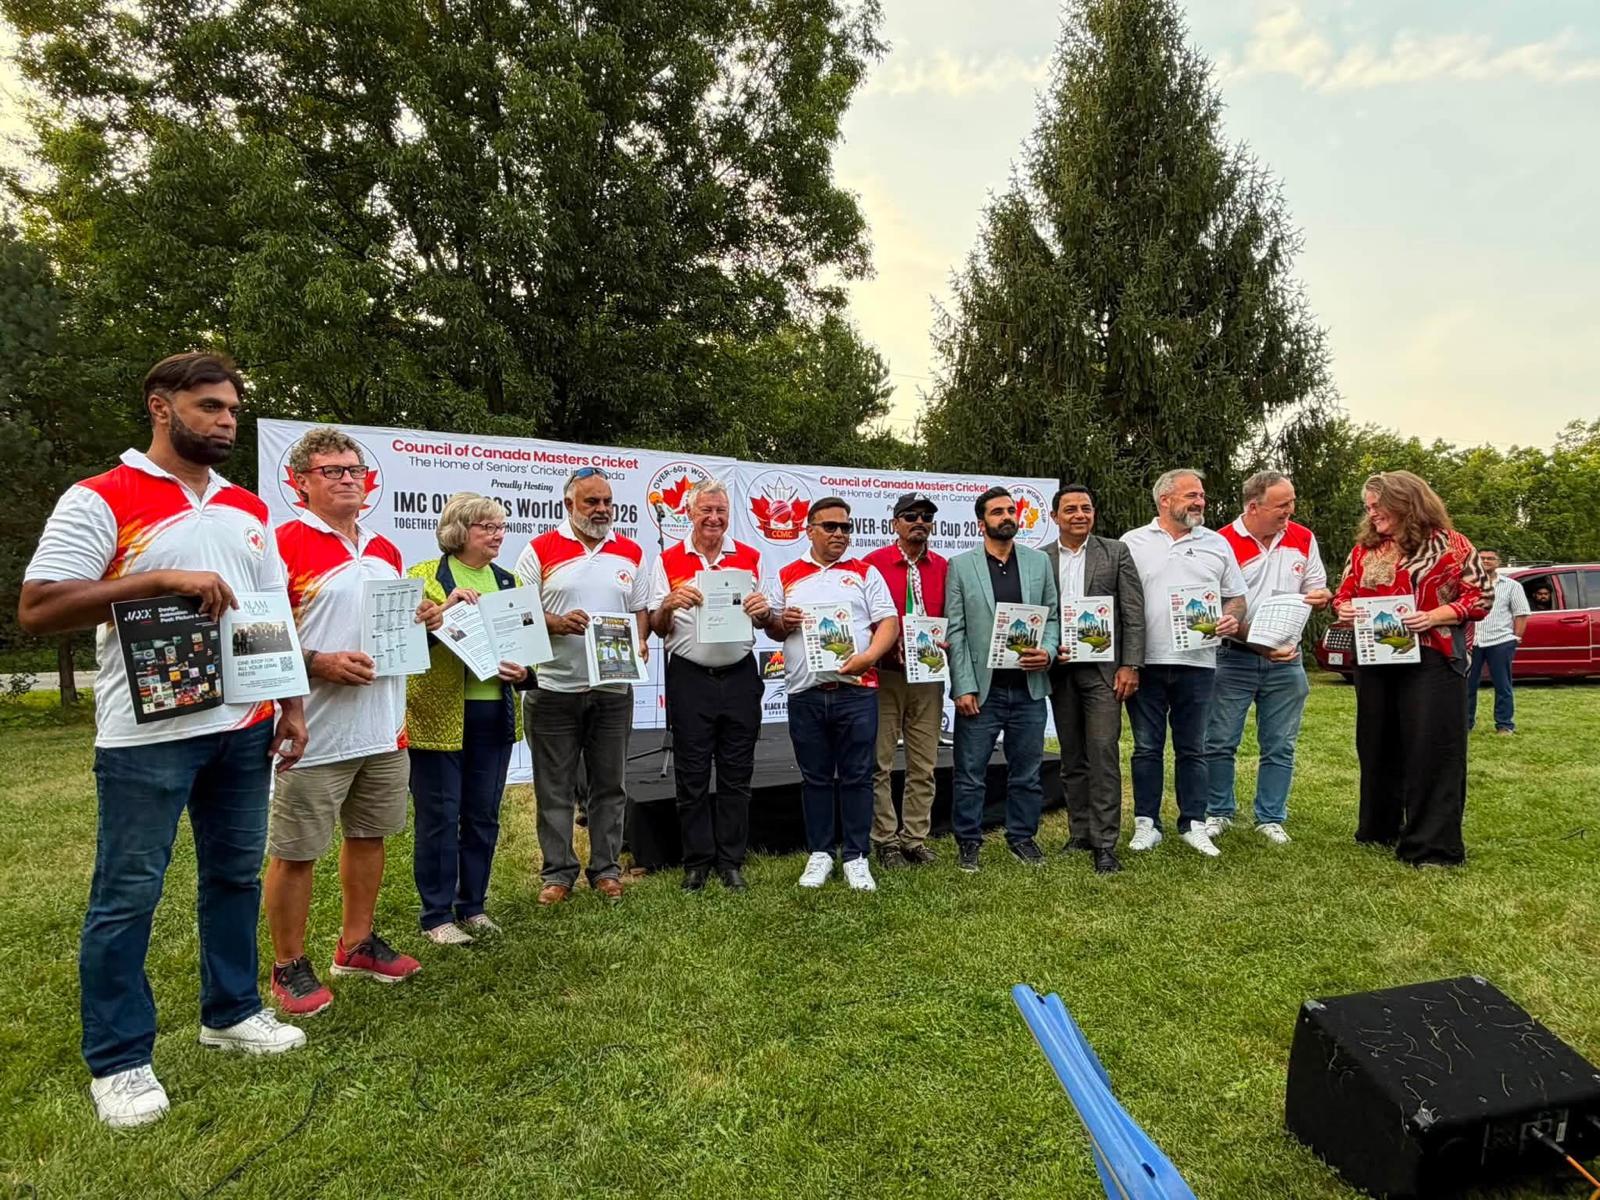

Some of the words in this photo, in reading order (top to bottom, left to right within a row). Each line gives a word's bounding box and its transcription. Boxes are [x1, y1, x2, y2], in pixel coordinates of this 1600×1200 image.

[392, 439, 452, 456] Council
[454, 444, 470, 457] of
[471, 446, 531, 461] Canada
[533, 450, 590, 466] Masters
[591, 455, 639, 469] Cricket
[409, 456, 431, 467] The
[434, 458, 470, 470] Home
[473, 460, 484, 471] of
[486, 461, 529, 474] Seniors'
[530, 464, 568, 477] Cricket
[490, 479, 522, 491] Proudly
[523, 481, 554, 493] Hosting
[653, 465, 687, 490] OVER-60s
[820, 475, 860, 487] Council
[861, 477, 872, 488] of
[873, 478, 914, 490] Canada
[915, 481, 955, 492] Masters
[955, 482, 989, 493] Cricket
[832, 488, 846, 497] The
[847, 489, 873, 498] Home
[874, 490, 881, 499] of
[394, 491, 427, 513] IMC
[516, 498, 563, 520] World
[940, 520, 961, 539] Cup
[764, 702, 781, 711] BLACK
